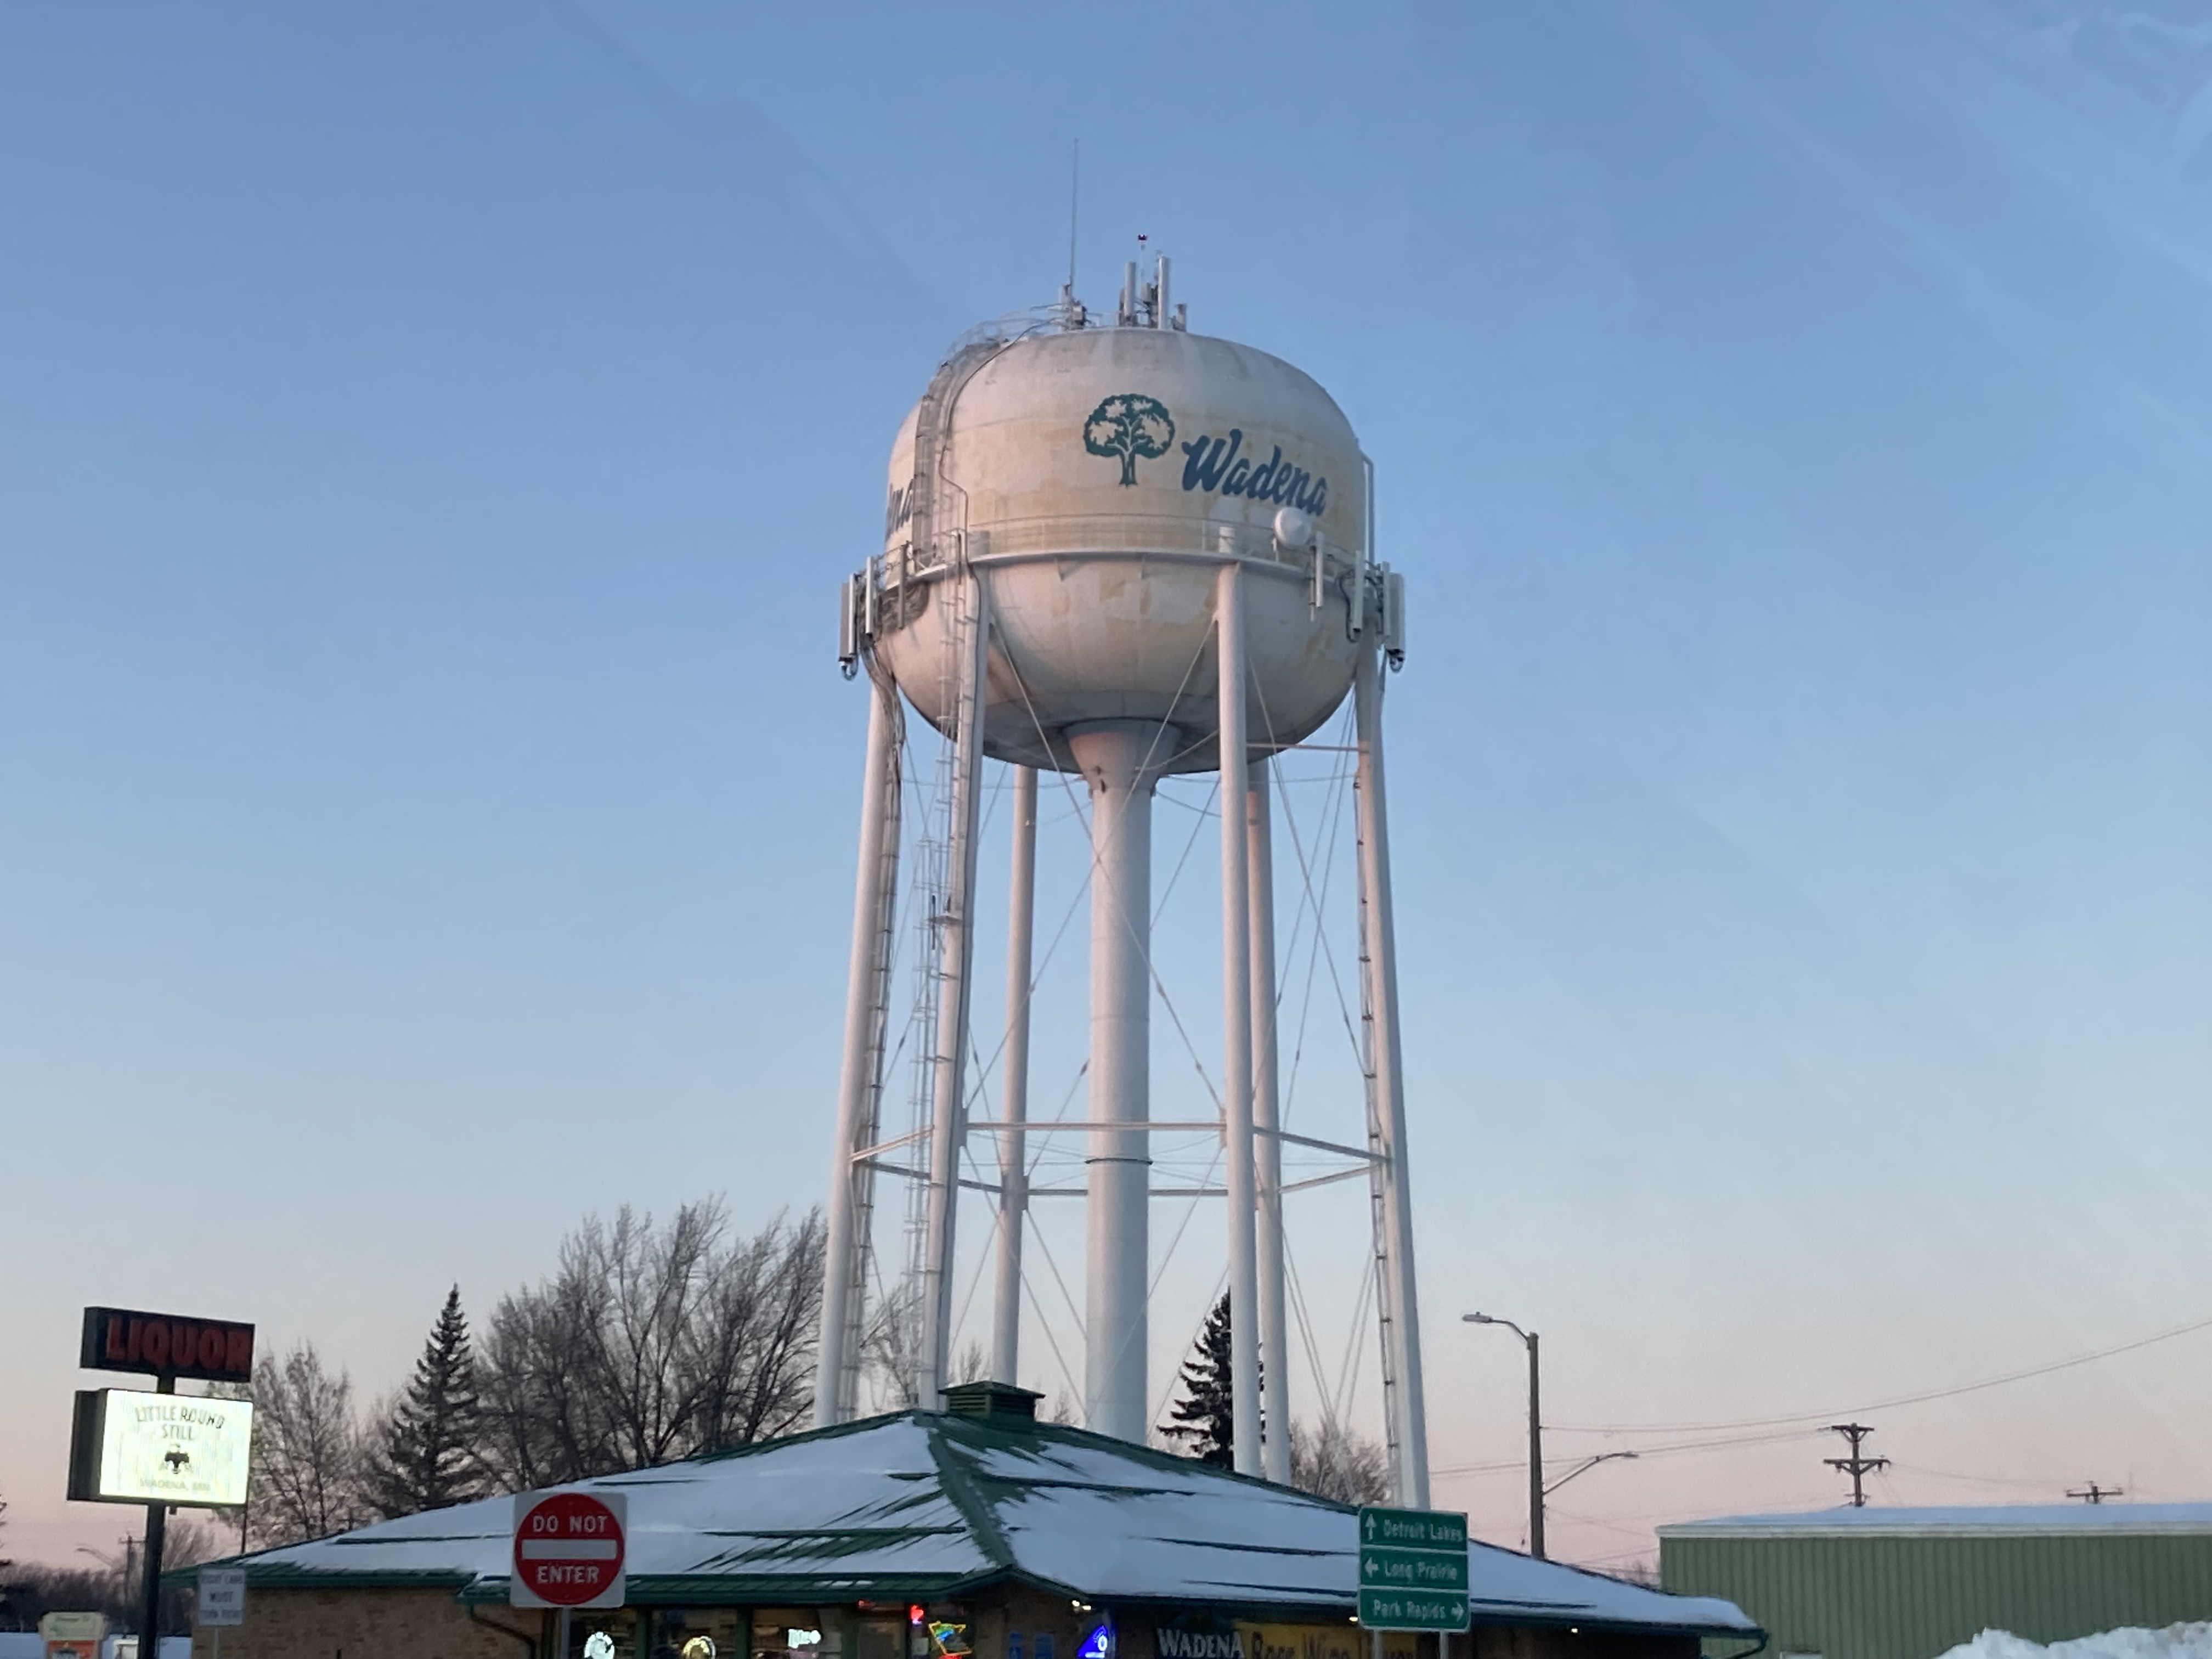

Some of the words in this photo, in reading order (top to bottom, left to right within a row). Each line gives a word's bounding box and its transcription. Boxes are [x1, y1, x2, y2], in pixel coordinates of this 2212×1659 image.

[1181, 428, 1328, 516] Wadena
[106, 1317, 252, 1373] LIQUOR
[135, 1406, 177, 1422] LITTLE
[180, 1406, 225, 1429] ROUND
[162, 1424, 196, 1441] STILL
[533, 1515, 558, 1533] DO
[569, 1515, 607, 1533] NOT
[1384, 1519, 1425, 1539] Detroit
[1430, 1523, 1463, 1542] Lakes
[537, 1565, 600, 1584] ENTER
[1384, 1561, 1413, 1584] Long
[1418, 1561, 1458, 1581] Prairie
[1374, 1599, 1402, 1617] Park
[1407, 1601, 1446, 1622] Rapids
[1156, 1627, 1245, 1658] WADENA
